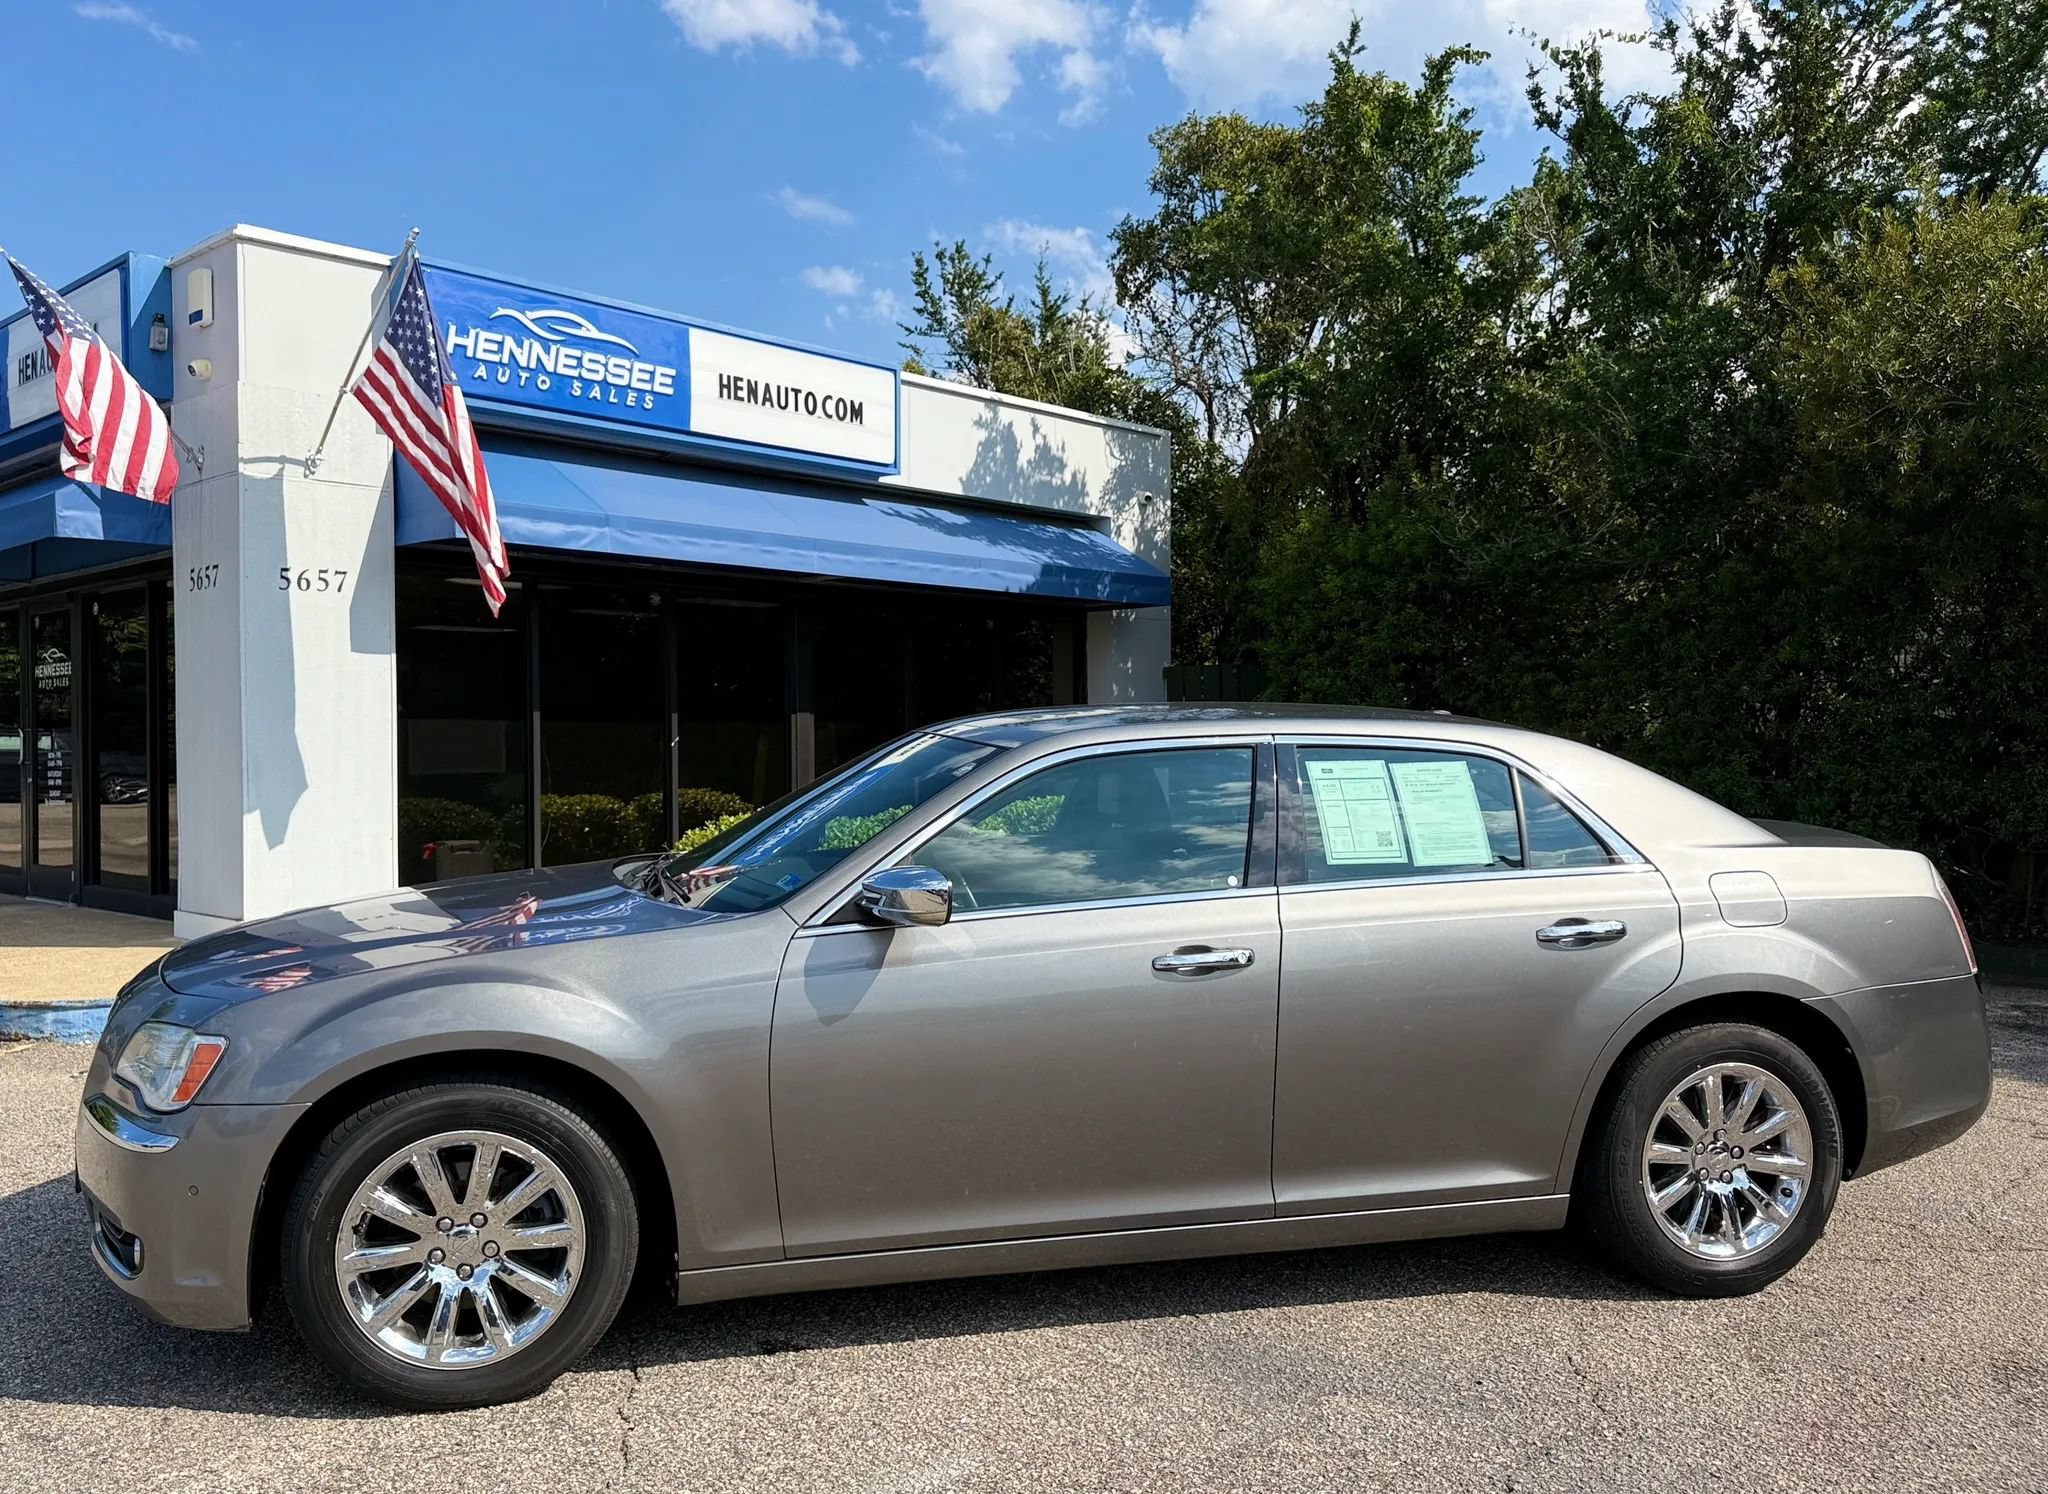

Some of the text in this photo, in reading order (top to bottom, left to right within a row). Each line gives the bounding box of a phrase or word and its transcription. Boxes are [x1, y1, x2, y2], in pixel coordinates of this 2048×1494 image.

[18, 346, 53, 387] HENAU
[446, 321, 677, 396] HENNESSEE
[473, 362, 654, 410] AUTO SALES
[189, 564, 219, 592] 5657
[278, 566, 348, 593] 5657
